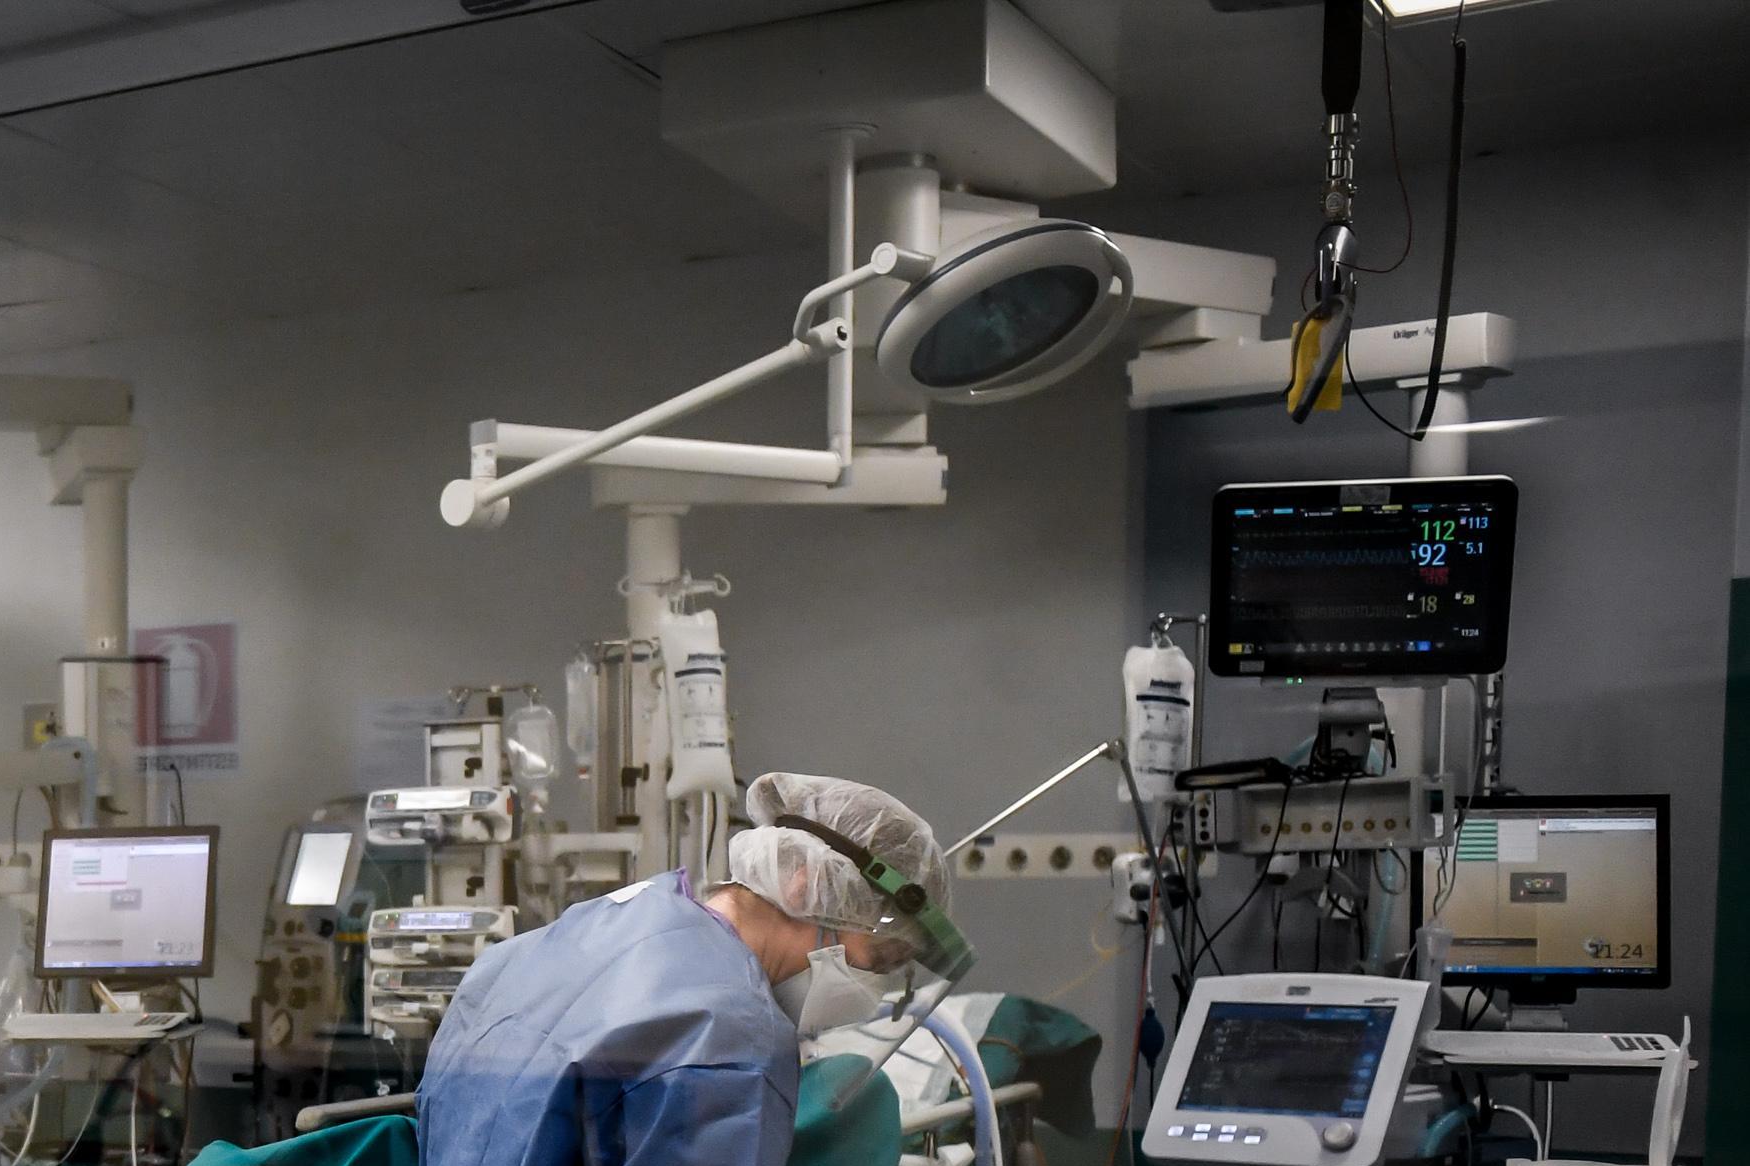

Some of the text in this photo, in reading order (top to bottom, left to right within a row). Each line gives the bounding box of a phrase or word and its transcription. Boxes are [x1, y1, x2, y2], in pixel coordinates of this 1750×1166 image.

[1420, 520, 1456, 542] 112
[1468, 516, 1489, 529] 113
[1418, 543, 1446, 566] 92
[1419, 595, 1438, 613] 18
